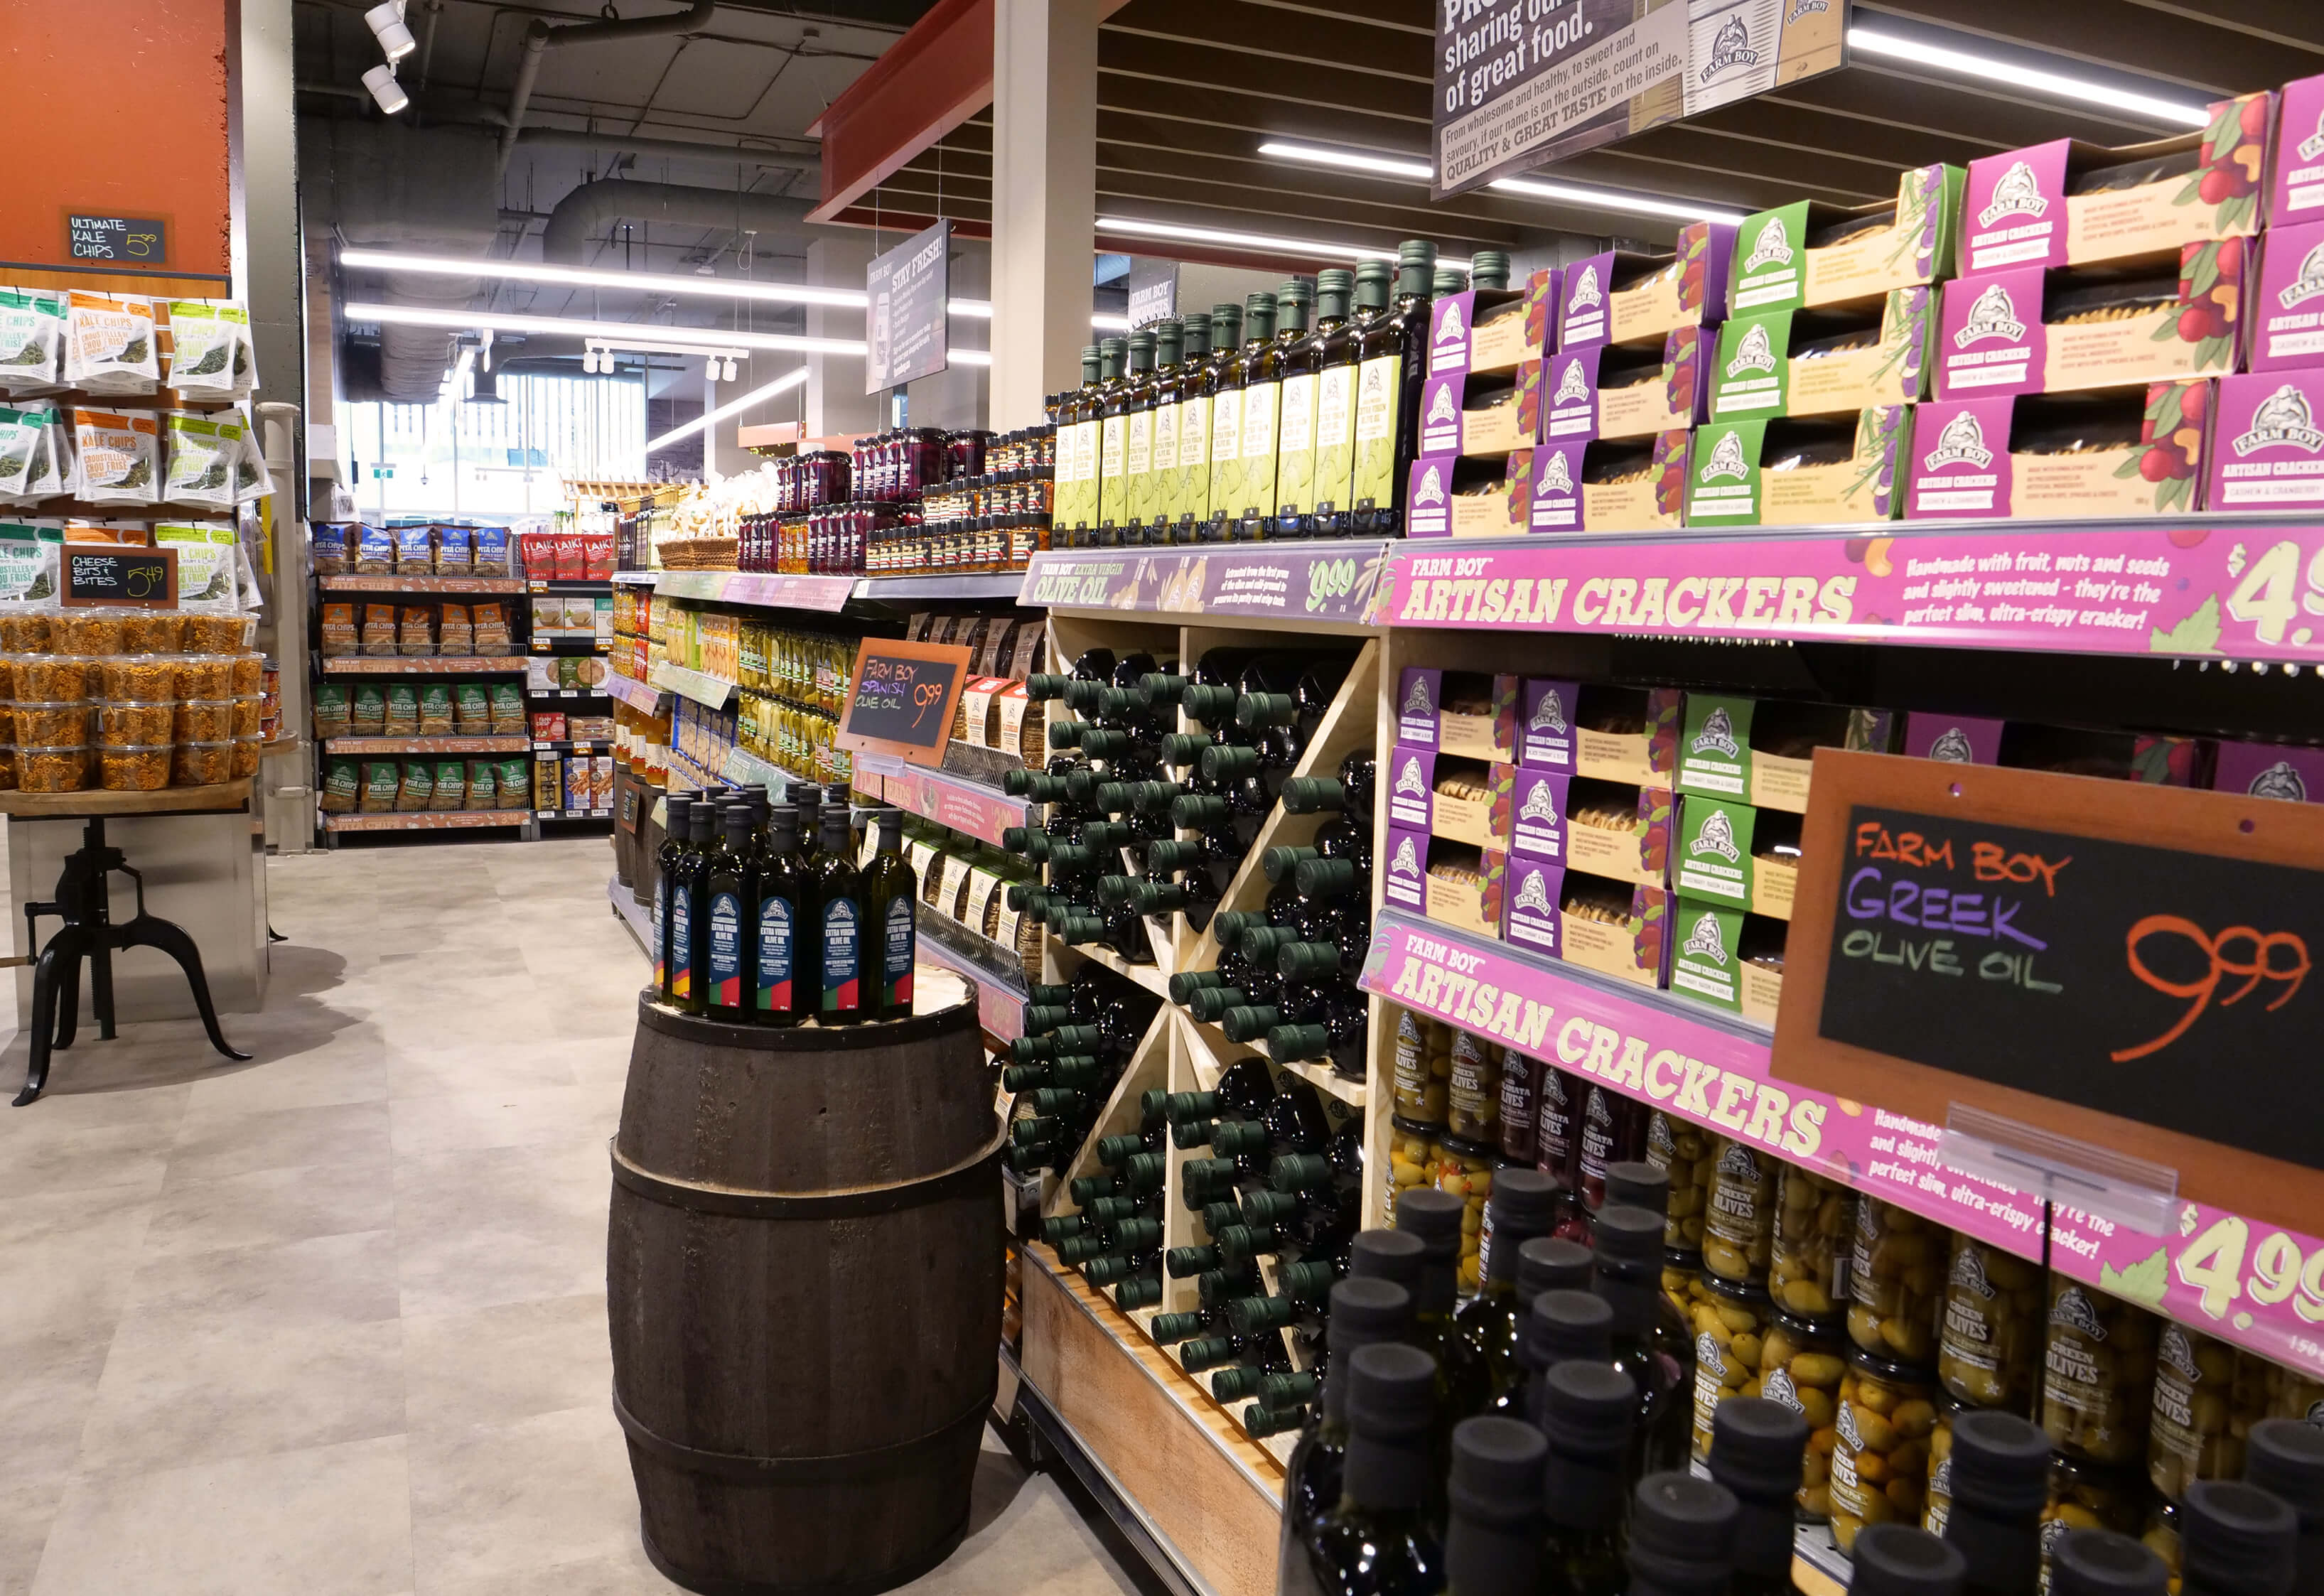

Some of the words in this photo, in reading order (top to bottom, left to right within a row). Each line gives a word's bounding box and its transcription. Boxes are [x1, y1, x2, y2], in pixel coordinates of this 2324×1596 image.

[1789, 4, 1809, 24] FARM
[1812, 2, 1829, 12] BOY
[1445, 1, 1522, 73] sharing
[1446, 70, 1465, 112] of
[1471, 39, 1526, 106] great
[1532, 0, 1593, 64] food.
[1702, 54, 1731, 80] FARM
[1735, 51, 1757, 63] BOY
[1446, 126, 1465, 144] From
[1468, 99, 1513, 132] wholesome
[1516, 90, 1532, 112] and
[1534, 69, 1569, 97] healthy,
[1573, 61, 1581, 75] to
[1585, 42, 1613, 69] sweet
[1616, 28, 1635, 52] and
[1446, 137, 1479, 163] savoury,
[1481, 129, 1487, 142] if
[1489, 124, 1503, 140] our
[1505, 111, 1528, 132] name
[1531, 104, 1539, 117] is
[1541, 98, 1552, 113] on
[1555, 89, 1569, 106] the
[1572, 68, 1610, 97] outside,
[1613, 48, 1642, 75] count
[1646, 41, 1659, 58] on
[1446, 140, 1499, 180] QUALITY
[1502, 137, 1510, 153] &
[1514, 111, 1558, 146] GREAT
[1561, 87, 1606, 122] TASTE
[1610, 82, 1623, 97] on
[1625, 72, 1642, 90] the
[1645, 53, 1682, 81] inside.
[71, 217, 127, 231] ULTIMATE
[72, 230, 106, 242] KALE
[74, 243, 114, 258] CHIPS
[893, 261, 911, 293] STAY
[913, 235, 942, 278] FRESH!
[1131, 286, 1151, 306] FARM
[1153, 281, 1169, 298] BOY
[1958, 322, 1993, 343] FARM
[1995, 322, 2023, 337] BOY
[82, 436, 104, 447] KALE
[108, 436, 136, 448] CHIPS
[2237, 428, 2283, 452] FARM
[2286, 428, 2322, 447] BOY
[1928, 448, 1964, 466] FARM
[1966, 448, 1989, 463] BOY
[1703, 463, 1726, 477] FARM
[1727, 463, 1745, 475] BOY
[13, 547, 43, 559] CHIPS
[555, 538, 583, 551] LAIKI
[586, 539, 613, 551] LAIKI
[72, 556, 119, 566] CHEESE
[1040, 564, 1060, 575] FARM
[1059, 564, 1075, 575] BOY
[1075, 564, 1099, 575] EXTRA
[1099, 564, 1124, 575] VIRGIN
[1411, 557, 1453, 577] FARM
[1454, 557, 1487, 577] BOY
[1906, 556, 1975, 578] Handmade
[1976, 551, 2013, 572] with
[2014, 551, 2051, 573] fruit,
[2055, 554, 2092, 573] nuts
[2093, 554, 2124, 574] and
[2126, 556, 2170, 577] seeds
[72, 576, 117, 586] BITES
[1034, 576, 1081, 603] OLIVE
[1080, 576, 1109, 604] OIL
[1903, 581, 1929, 601] and
[1930, 576, 1981, 601] slightly
[1983, 576, 2060, 598] sweetened
[2074, 578, 2131, 603] they're
[2133, 582, 2162, 604] the
[1400, 578, 1569, 623] ARTISAN
[1573, 575, 1858, 627] CRACKERS
[488, 621, 505, 630] CHIPS
[1903, 605, 1953, 626] perfect
[1954, 603, 1986, 623] slim,
[1989, 603, 2077, 627] ultra-crispy
[2078, 609, 2148, 631] cracker!
[865, 659, 893, 680] FARM
[895, 664, 919, 684] BOY
[861, 681, 905, 697] SPANISH
[881, 699, 901, 709] OIL
[1694, 737, 1717, 750] FARM
[1718, 738, 1736, 755] BOY
[1692, 840, 1717, 852] FARM
[1718, 843, 1738, 859] BOY
[1856, 822, 1955, 870] FARM
[1971, 842, 2072, 896] BOY
[1846, 866, 2048, 949] GREEK
[1406, 934, 1446, 966] FARM
[1448, 947, 1480, 975] BOY
[1842, 930, 1964, 975] OLIVE
[1979, 953, 2064, 993] OIL
[1391, 957, 1555, 1052] ARTISAN
[1557, 1016, 1829, 1158] CRACKERS
[1874, 1109, 1942, 1142] Handmade
[1870, 1134, 1896, 1153] and
[1714, 1193, 1754, 1219] OLIVES
[1718, 1185, 1752, 1203] GREEN
[1868, 1159, 1917, 1187] perfect
[1918, 1174, 1947, 1199] slim,
[1951, 1185, 2035, 1236] ultra-crispy
[2034, 1219, 2101, 1261] cacker!
[2050, 1340, 2094, 1365] GREEN
[2046, 1349, 2099, 1384] OLIVES
